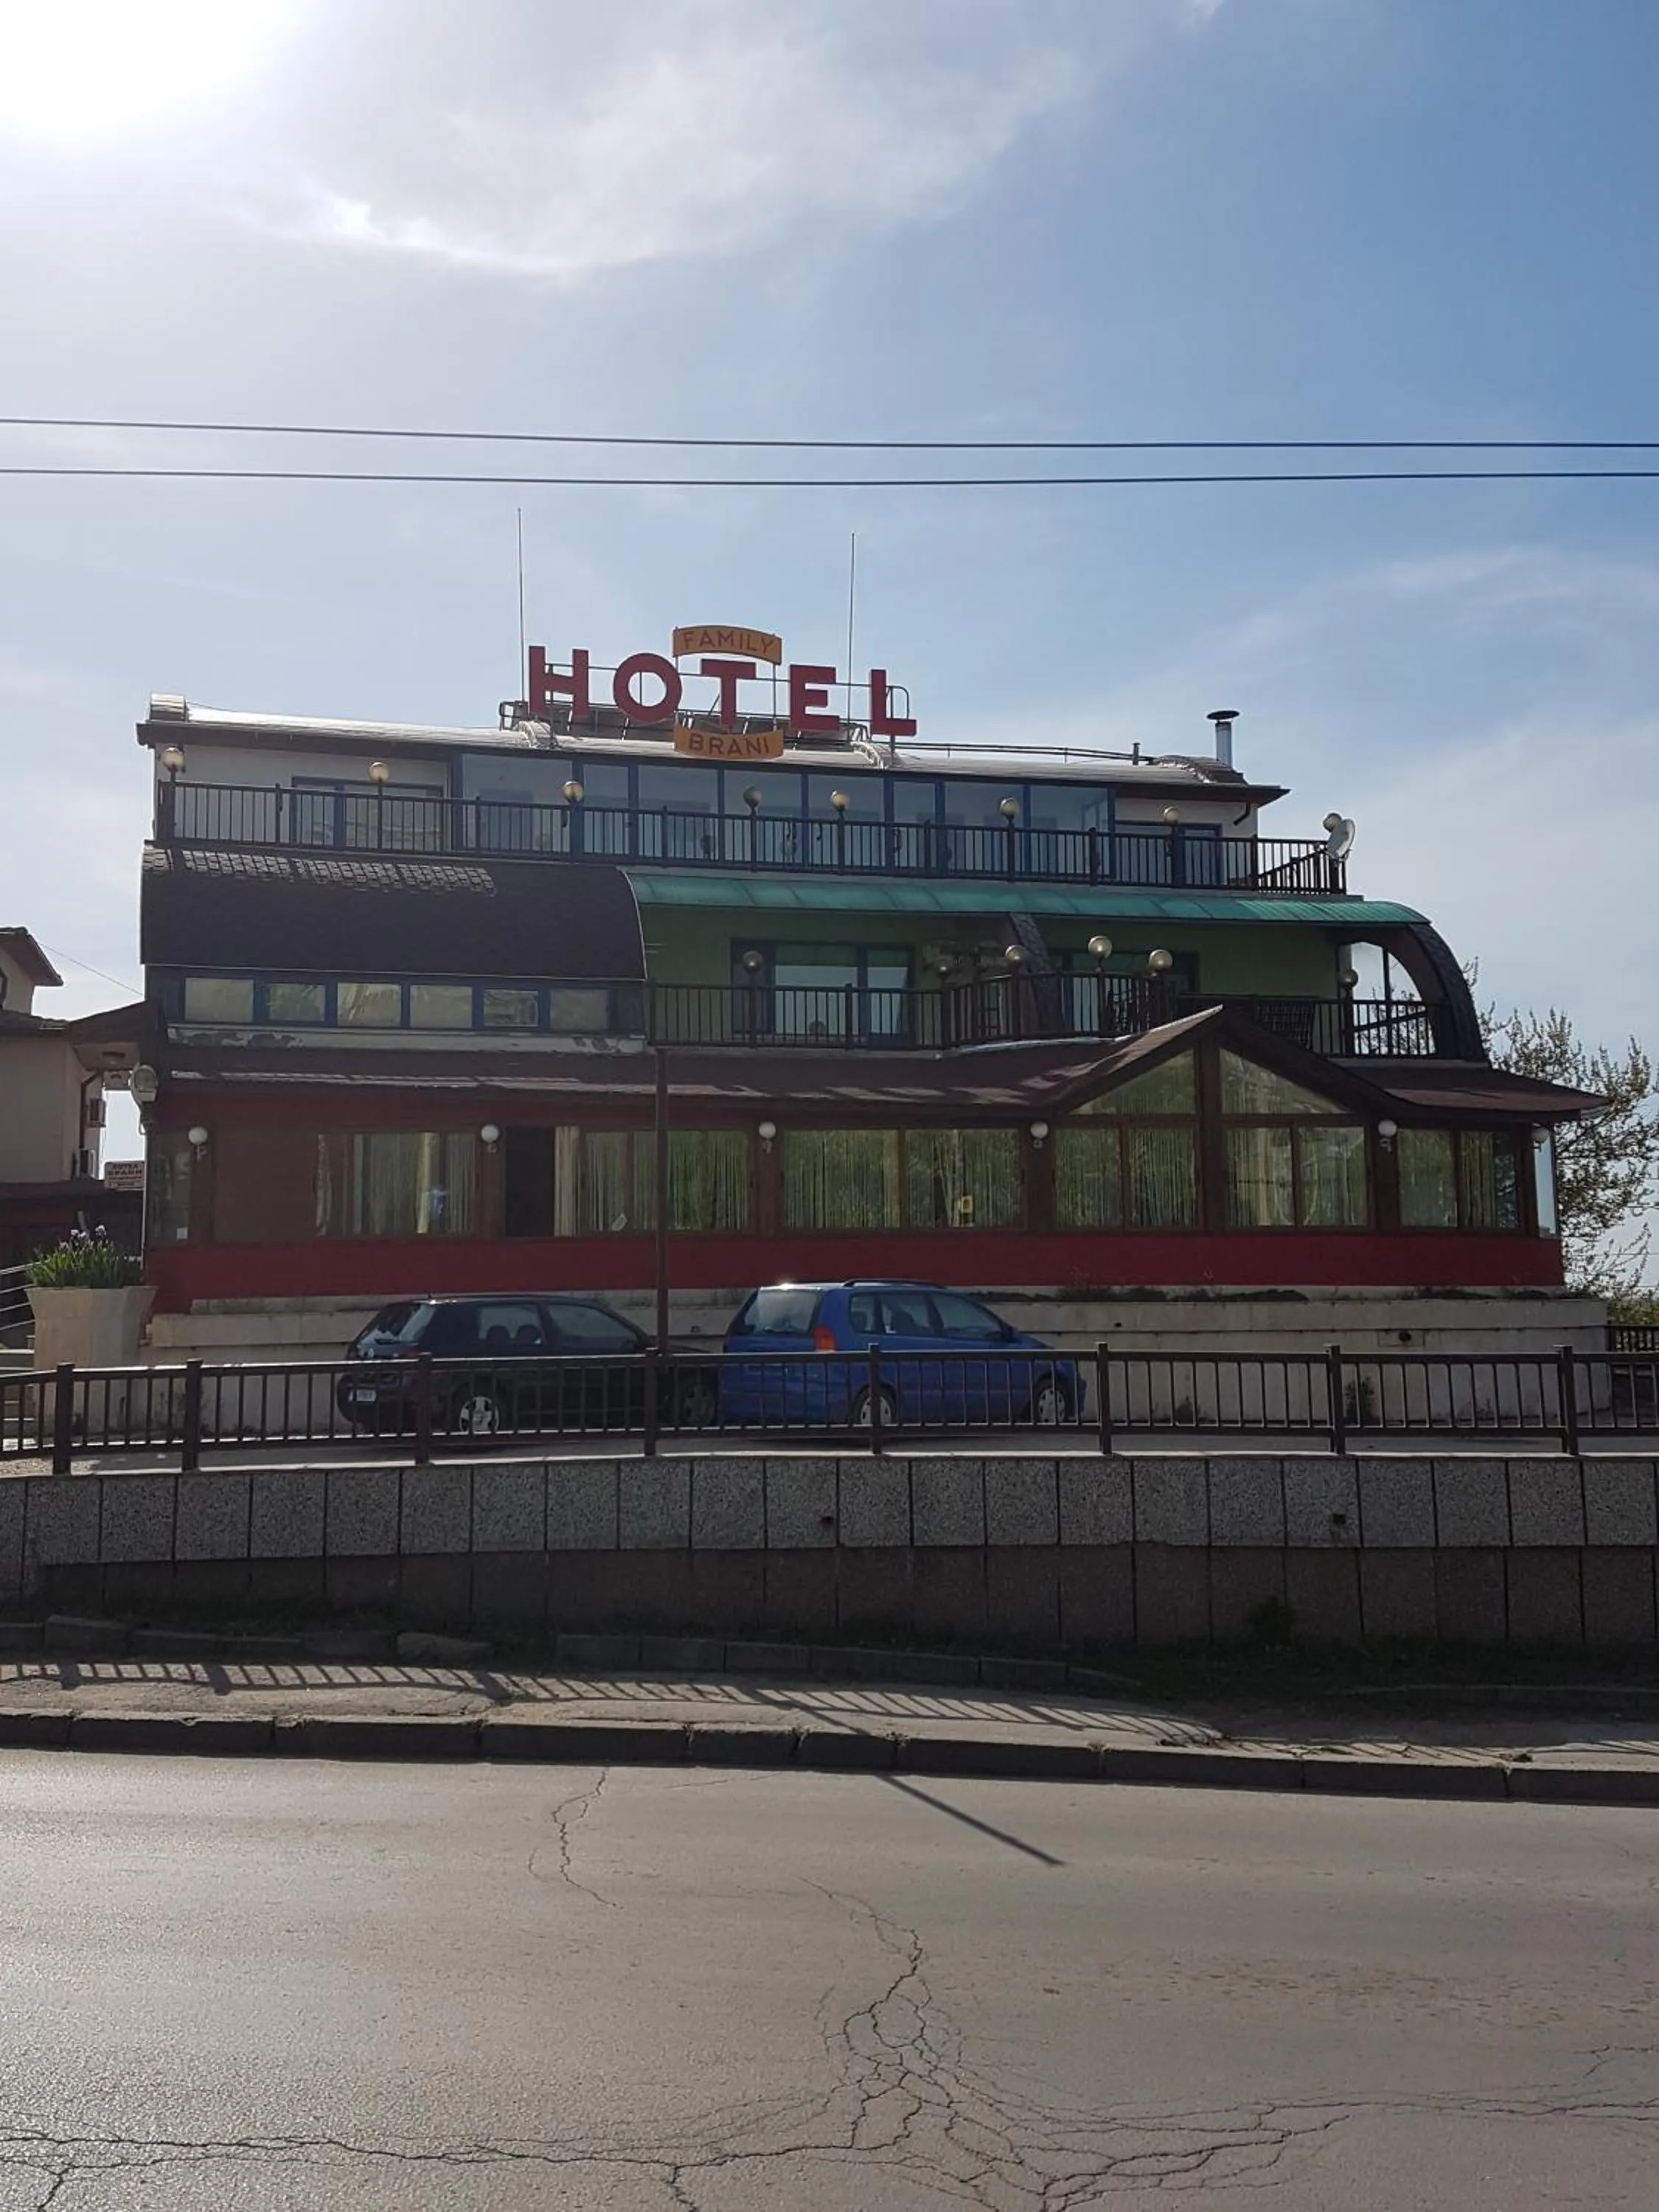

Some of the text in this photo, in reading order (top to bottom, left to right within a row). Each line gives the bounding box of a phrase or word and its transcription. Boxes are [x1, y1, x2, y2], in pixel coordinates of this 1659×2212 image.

[682, 629, 773, 654] FAMILY
[528, 645, 917, 737] HOTEL
[689, 730, 770, 756] BRANI
